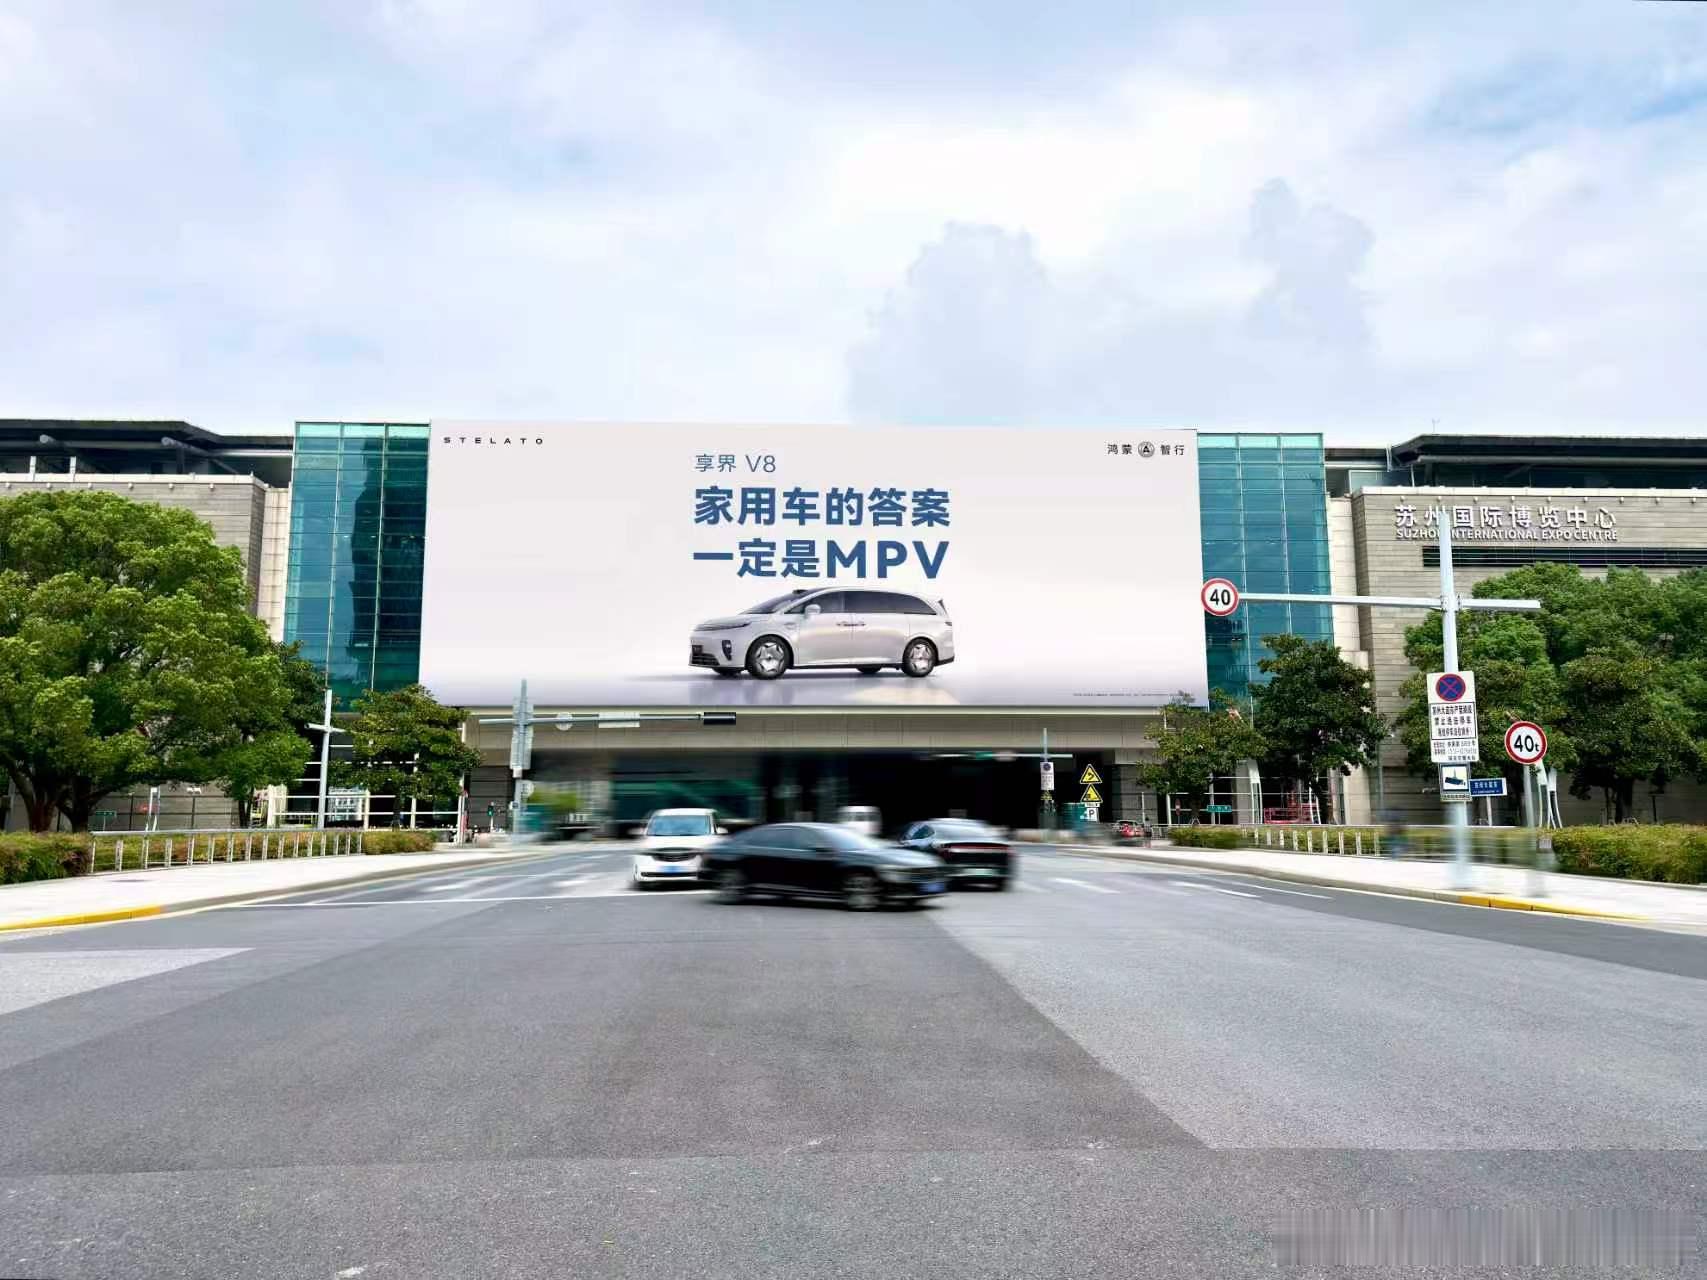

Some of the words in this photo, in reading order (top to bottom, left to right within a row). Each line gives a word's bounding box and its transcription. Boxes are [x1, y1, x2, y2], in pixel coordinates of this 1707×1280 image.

[443, 436, 543, 446] STELATO
[695, 454, 737, 473] 享界
[745, 455, 776, 473] V8
[694, 485, 951, 527] 家用车的答案
[1394, 504, 1617, 529] 苏州国际博览中心
[1396, 528, 1441, 540] SUZHO
[1451, 528, 1538, 540] NTERNATIONAL
[1541, 529, 1572, 541] EXPO
[1573, 529, 1618, 541] CENTRE
[693, 538, 950, 579] 一定是MPV
[1209, 588, 1231, 606] 40
[1513, 734, 1540, 752] 40t
